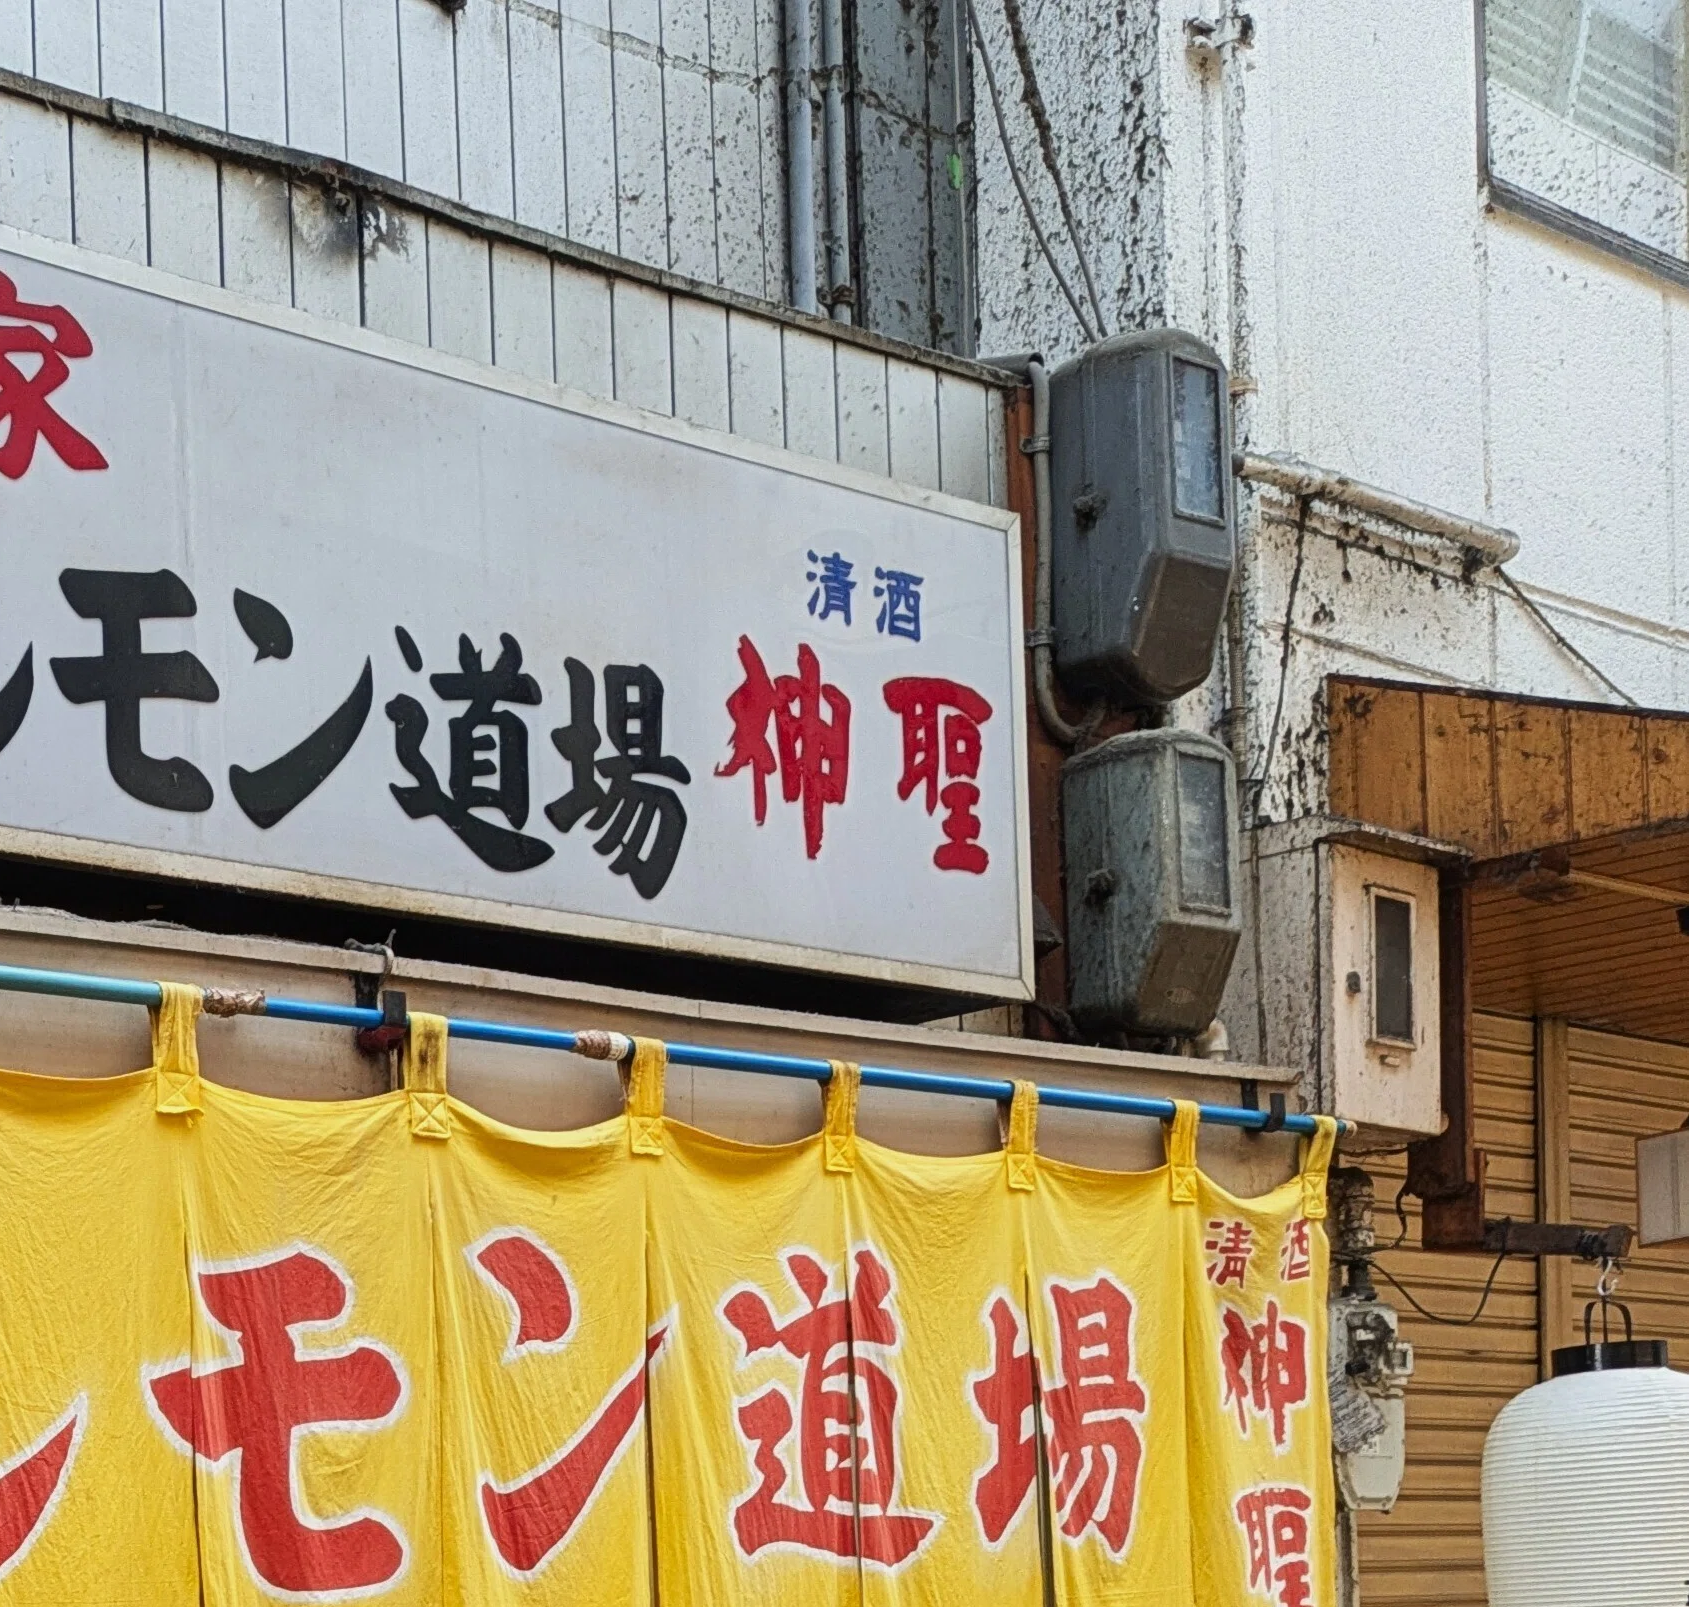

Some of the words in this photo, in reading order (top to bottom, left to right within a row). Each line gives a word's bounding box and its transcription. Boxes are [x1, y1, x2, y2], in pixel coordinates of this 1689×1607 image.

[807, 550, 922, 642] 清酒
[714, 634, 993, 875] 神聖
[1205, 1220, 1311, 1289] 清酒
